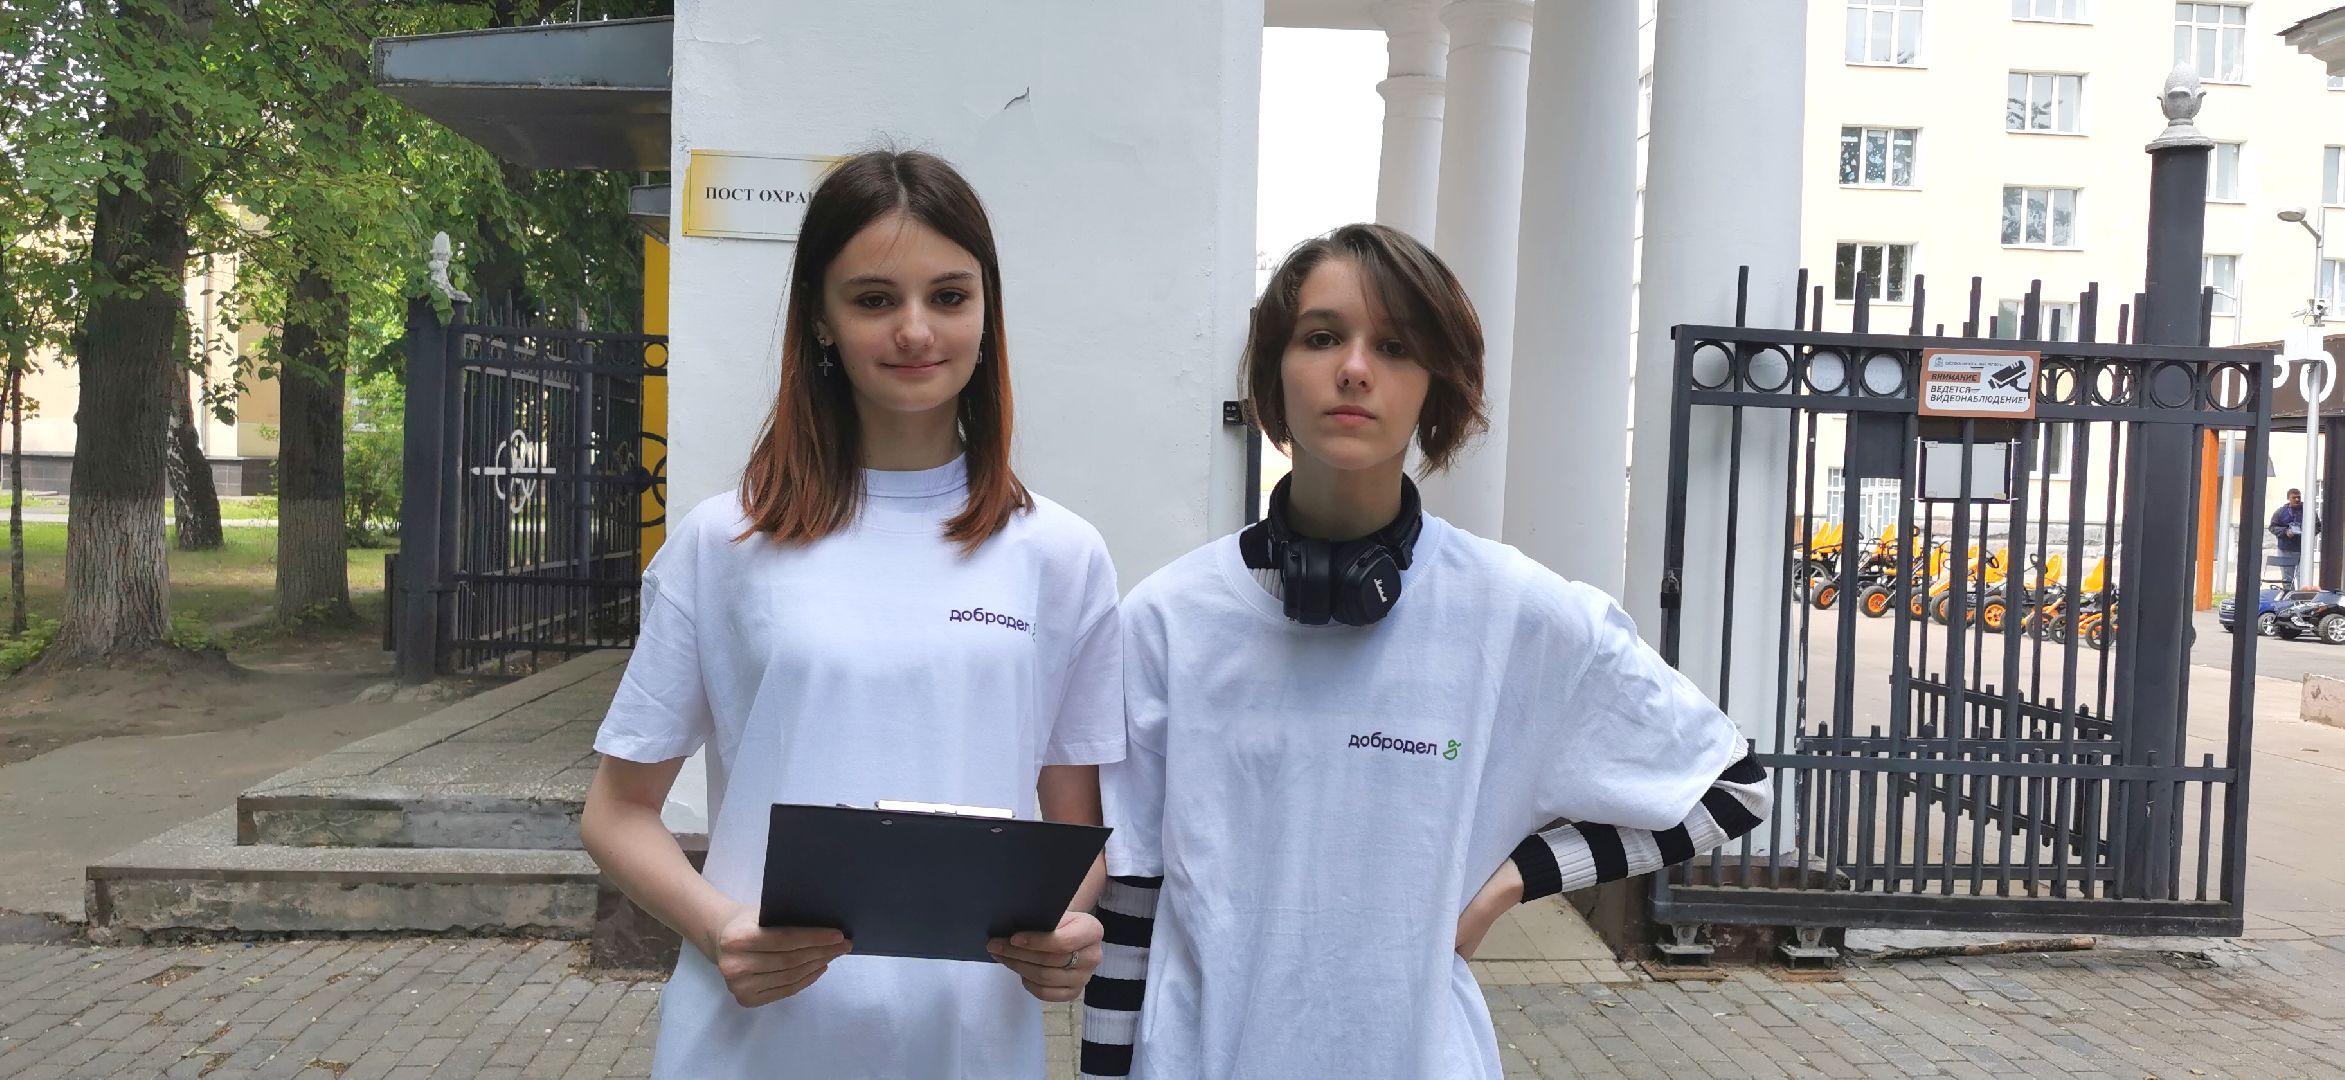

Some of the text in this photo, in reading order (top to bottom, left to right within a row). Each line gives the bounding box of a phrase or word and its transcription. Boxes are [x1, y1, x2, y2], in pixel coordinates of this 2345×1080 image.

[705, 187, 755, 201] ПОСТ
[1931, 373, 1978, 382] ВНИМАНИЕ
[1930, 385, 1971, 394] ВЕДЕТСЯ
[1930, 394, 2027, 405] ВИДЕОНАБЛЮДЕНИЕ!
[1348, 731, 1438, 756] добродел
